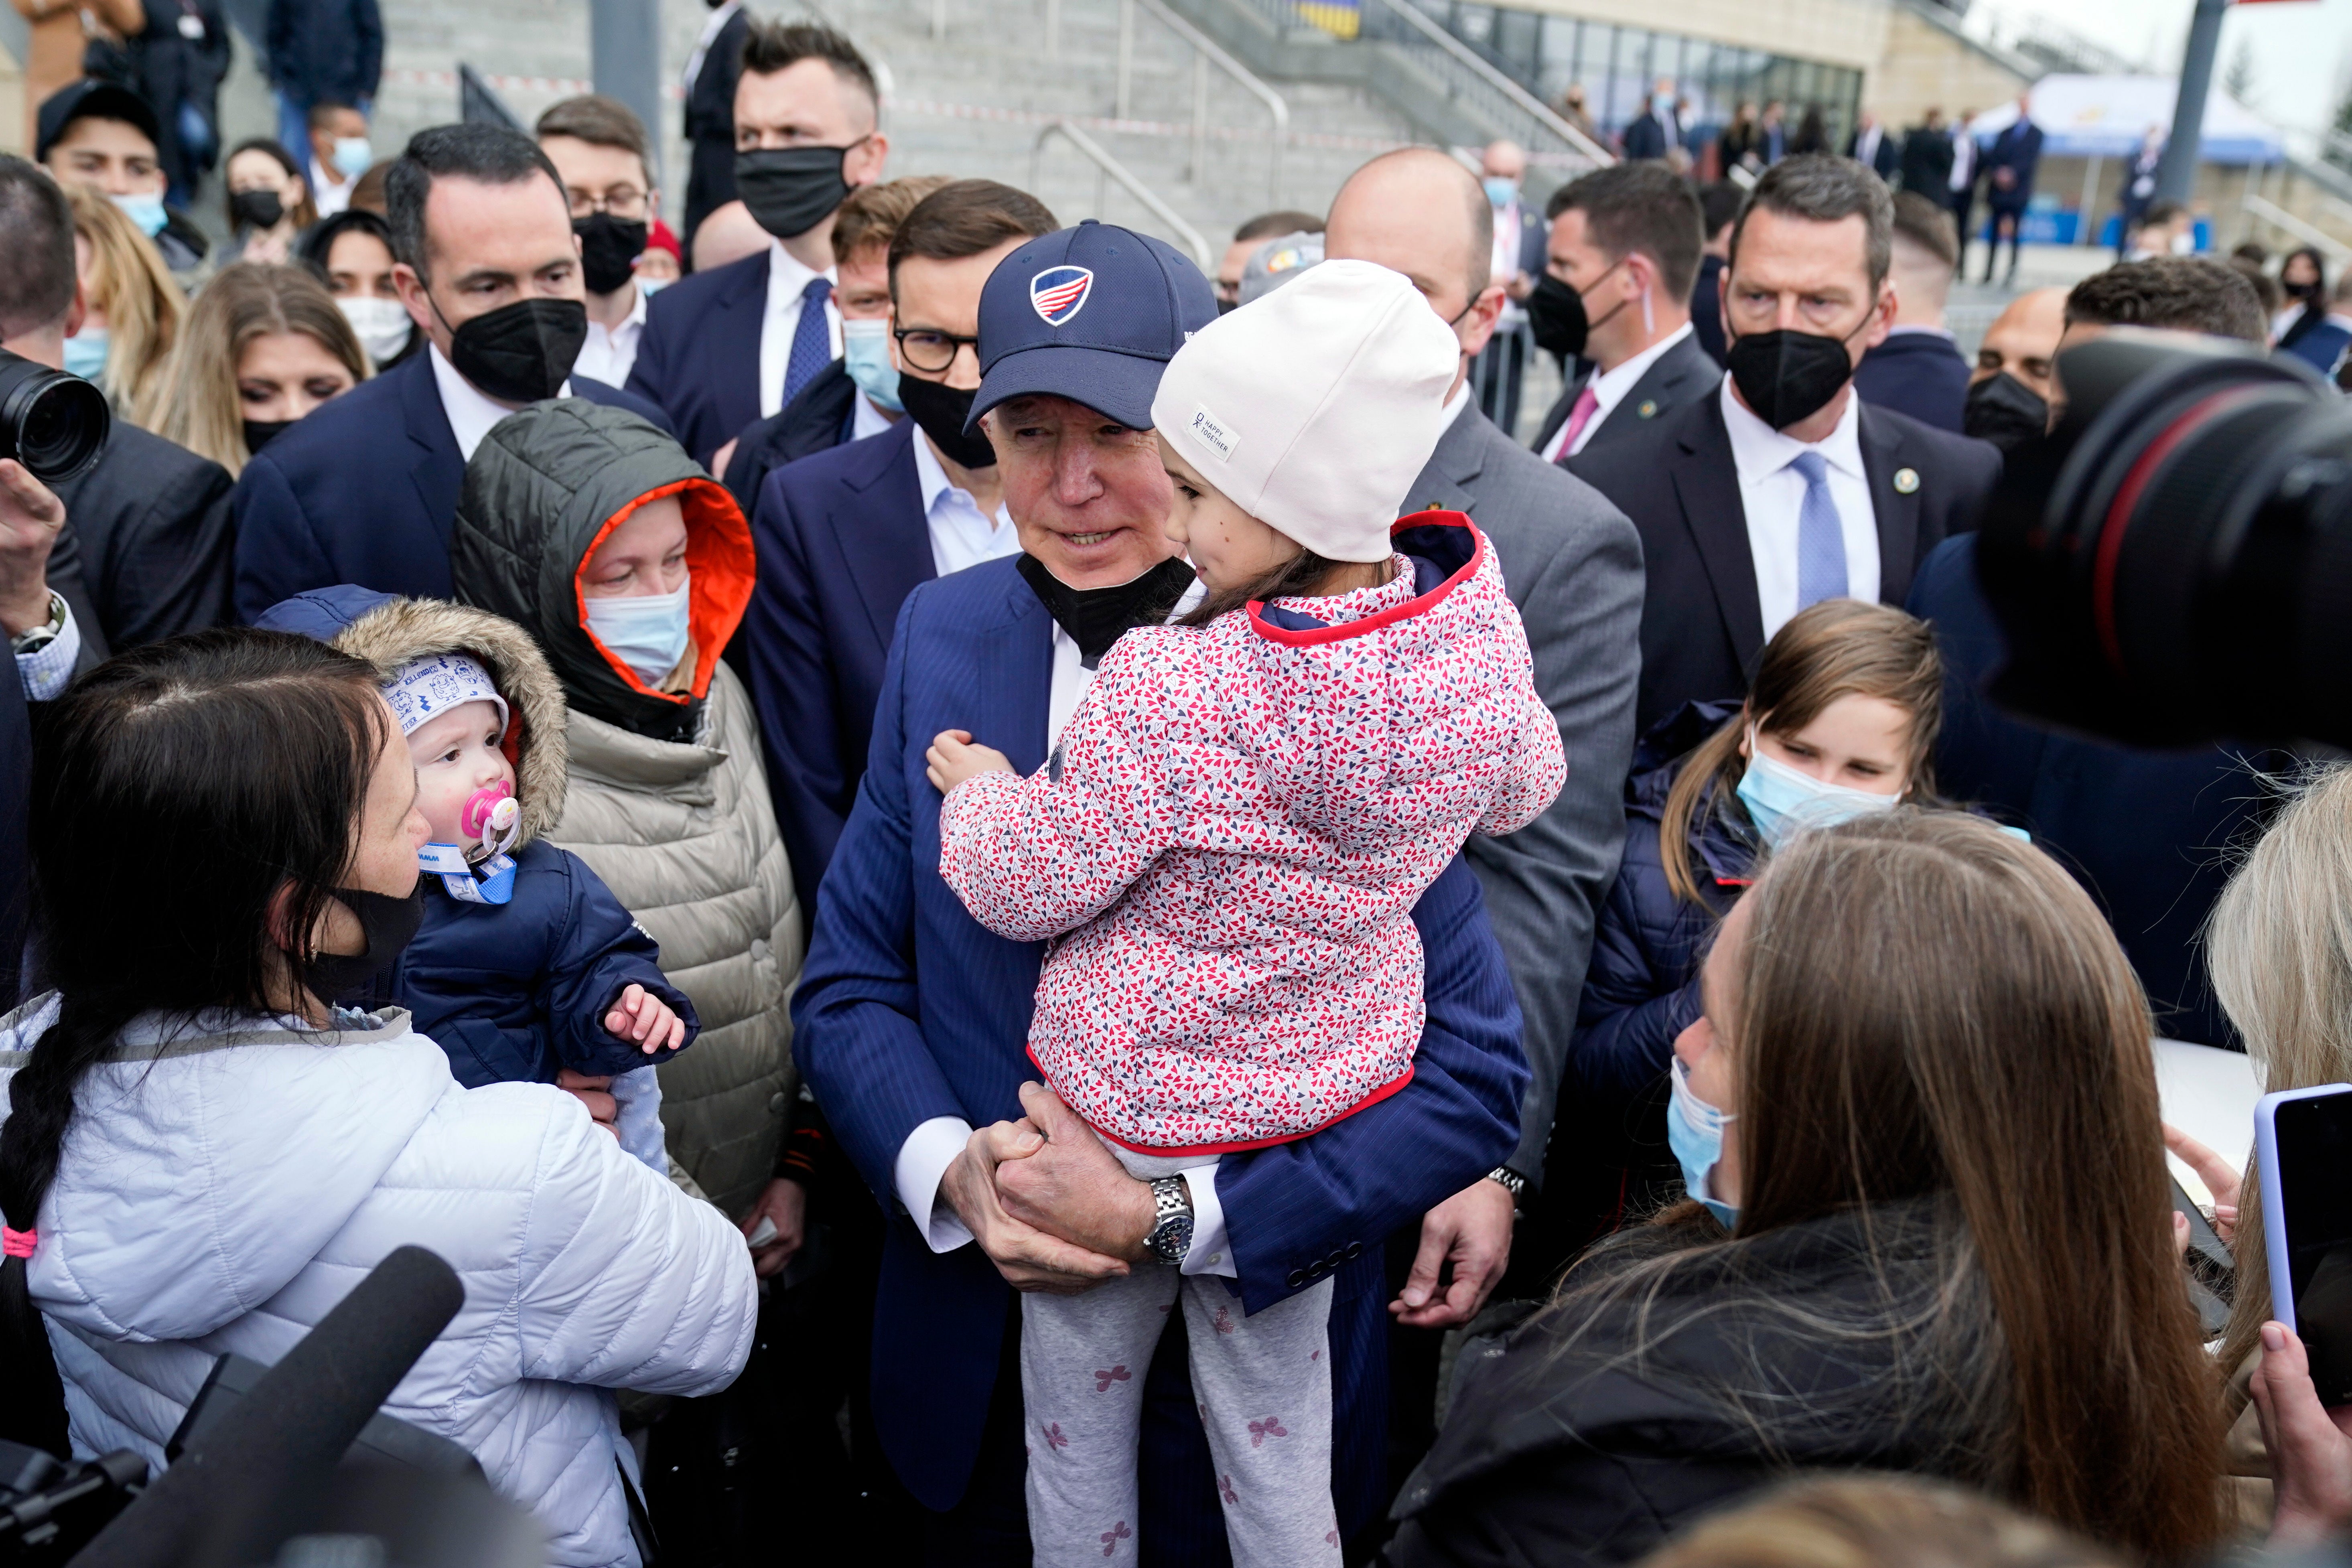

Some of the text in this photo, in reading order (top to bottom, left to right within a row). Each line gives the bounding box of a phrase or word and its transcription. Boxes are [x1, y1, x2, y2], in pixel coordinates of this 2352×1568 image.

[1205, 420, 1224, 437] HAPPY
[1201, 427, 1228, 452] TOGETHER
[404, 665, 438, 685] MONSTER
